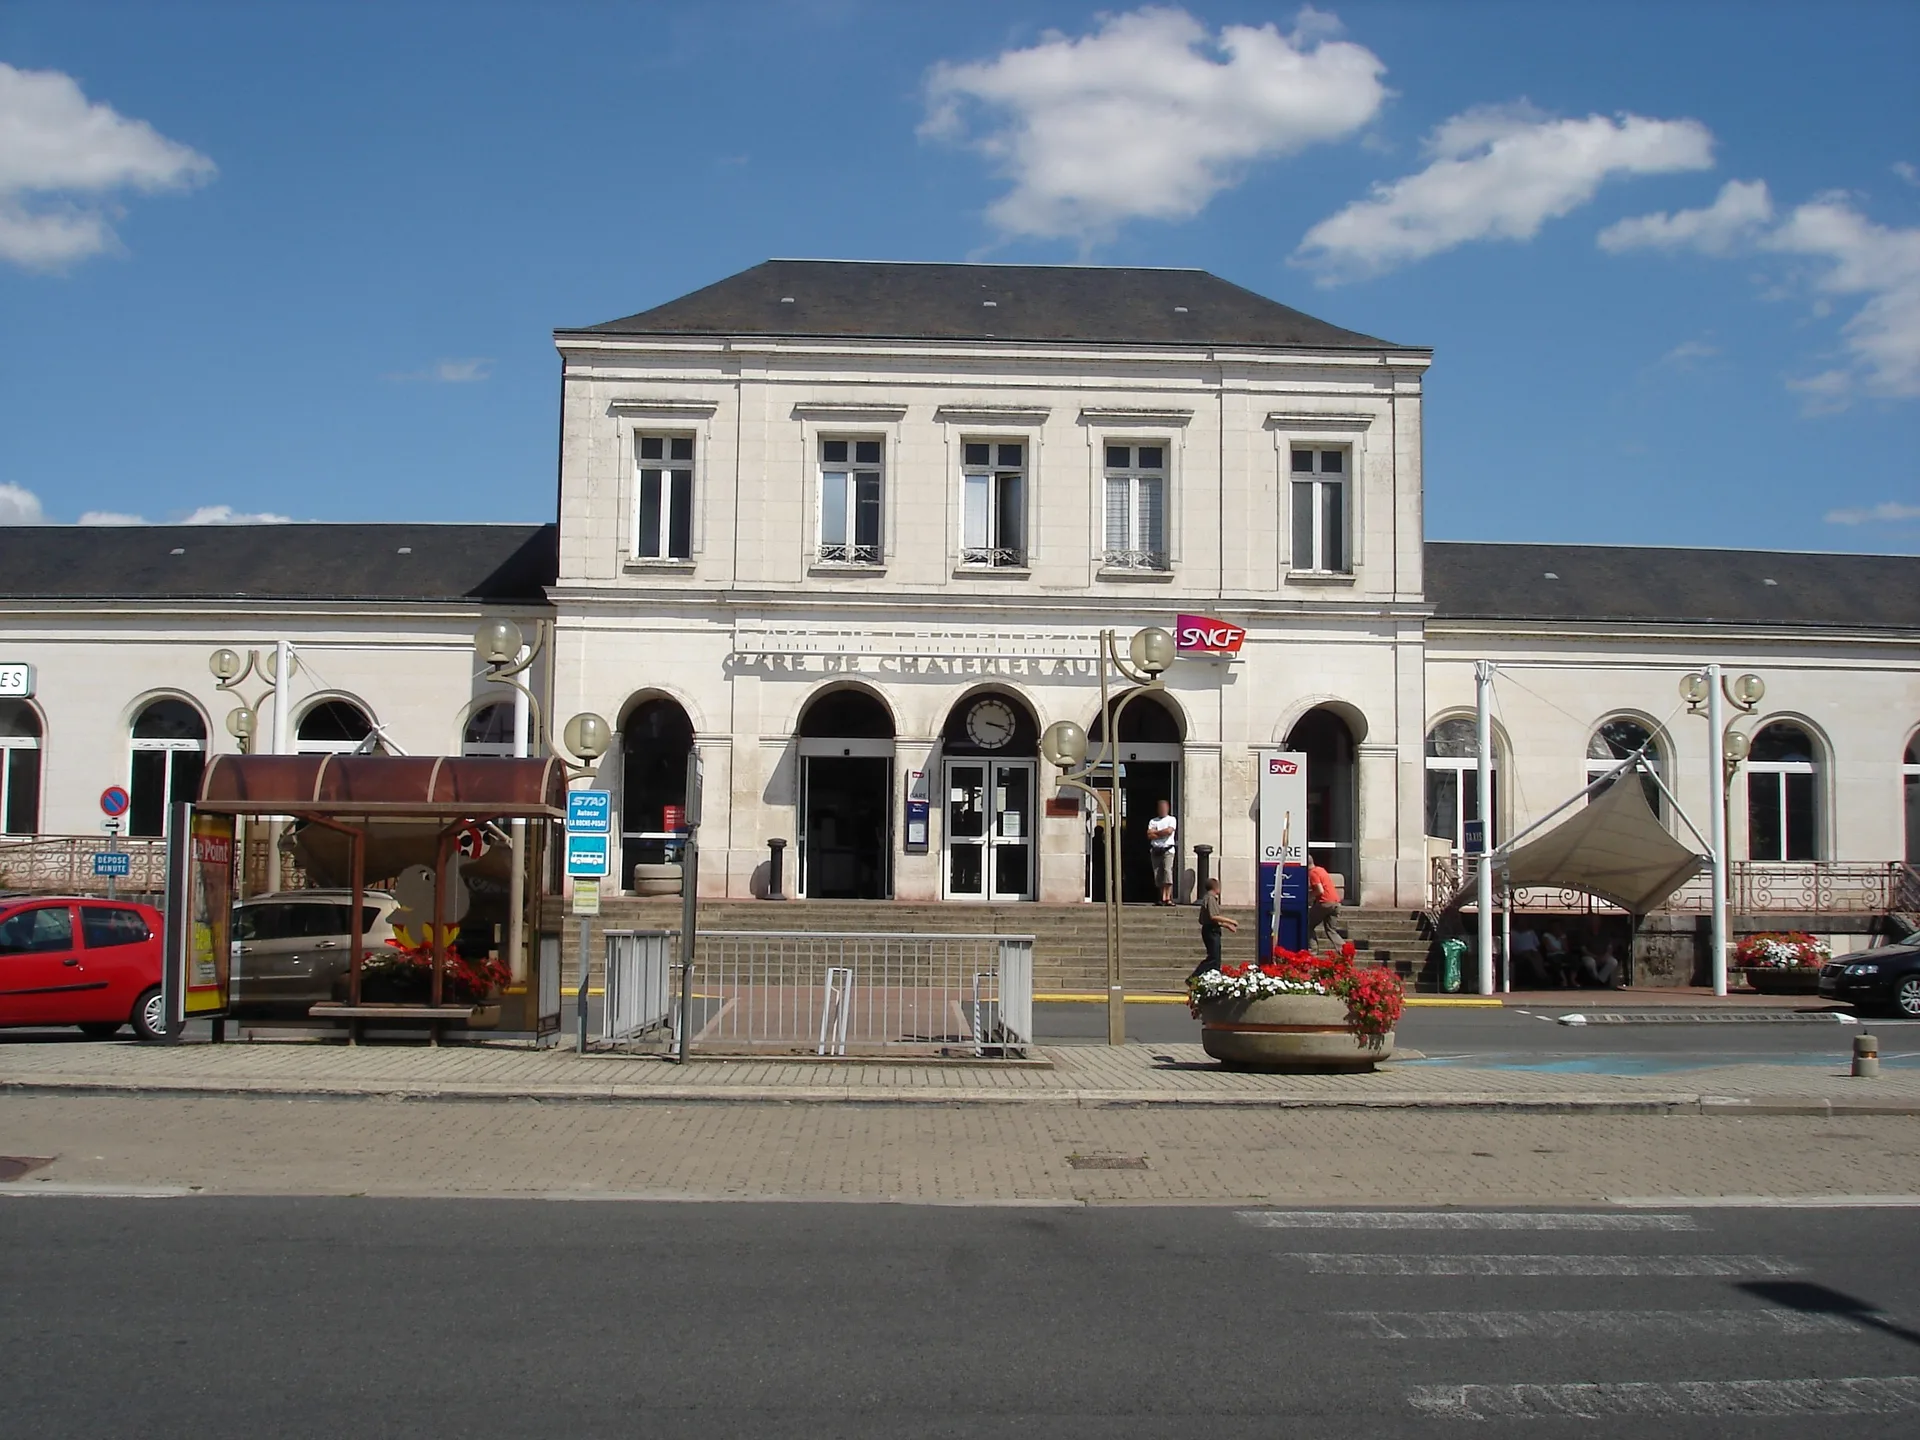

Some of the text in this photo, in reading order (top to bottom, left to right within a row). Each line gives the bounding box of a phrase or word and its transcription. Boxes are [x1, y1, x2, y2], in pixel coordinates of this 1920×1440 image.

[1180, 628, 1242, 647] SNCF
[0, 672, 22, 687] ES
[1270, 764, 1297, 773] SNCF
[1465, 831, 1482, 842] TAXIS
[192, 837, 228, 863] Le Point
[1265, 845, 1302, 858] GARE
[97, 864, 127, 872] MINUTE
